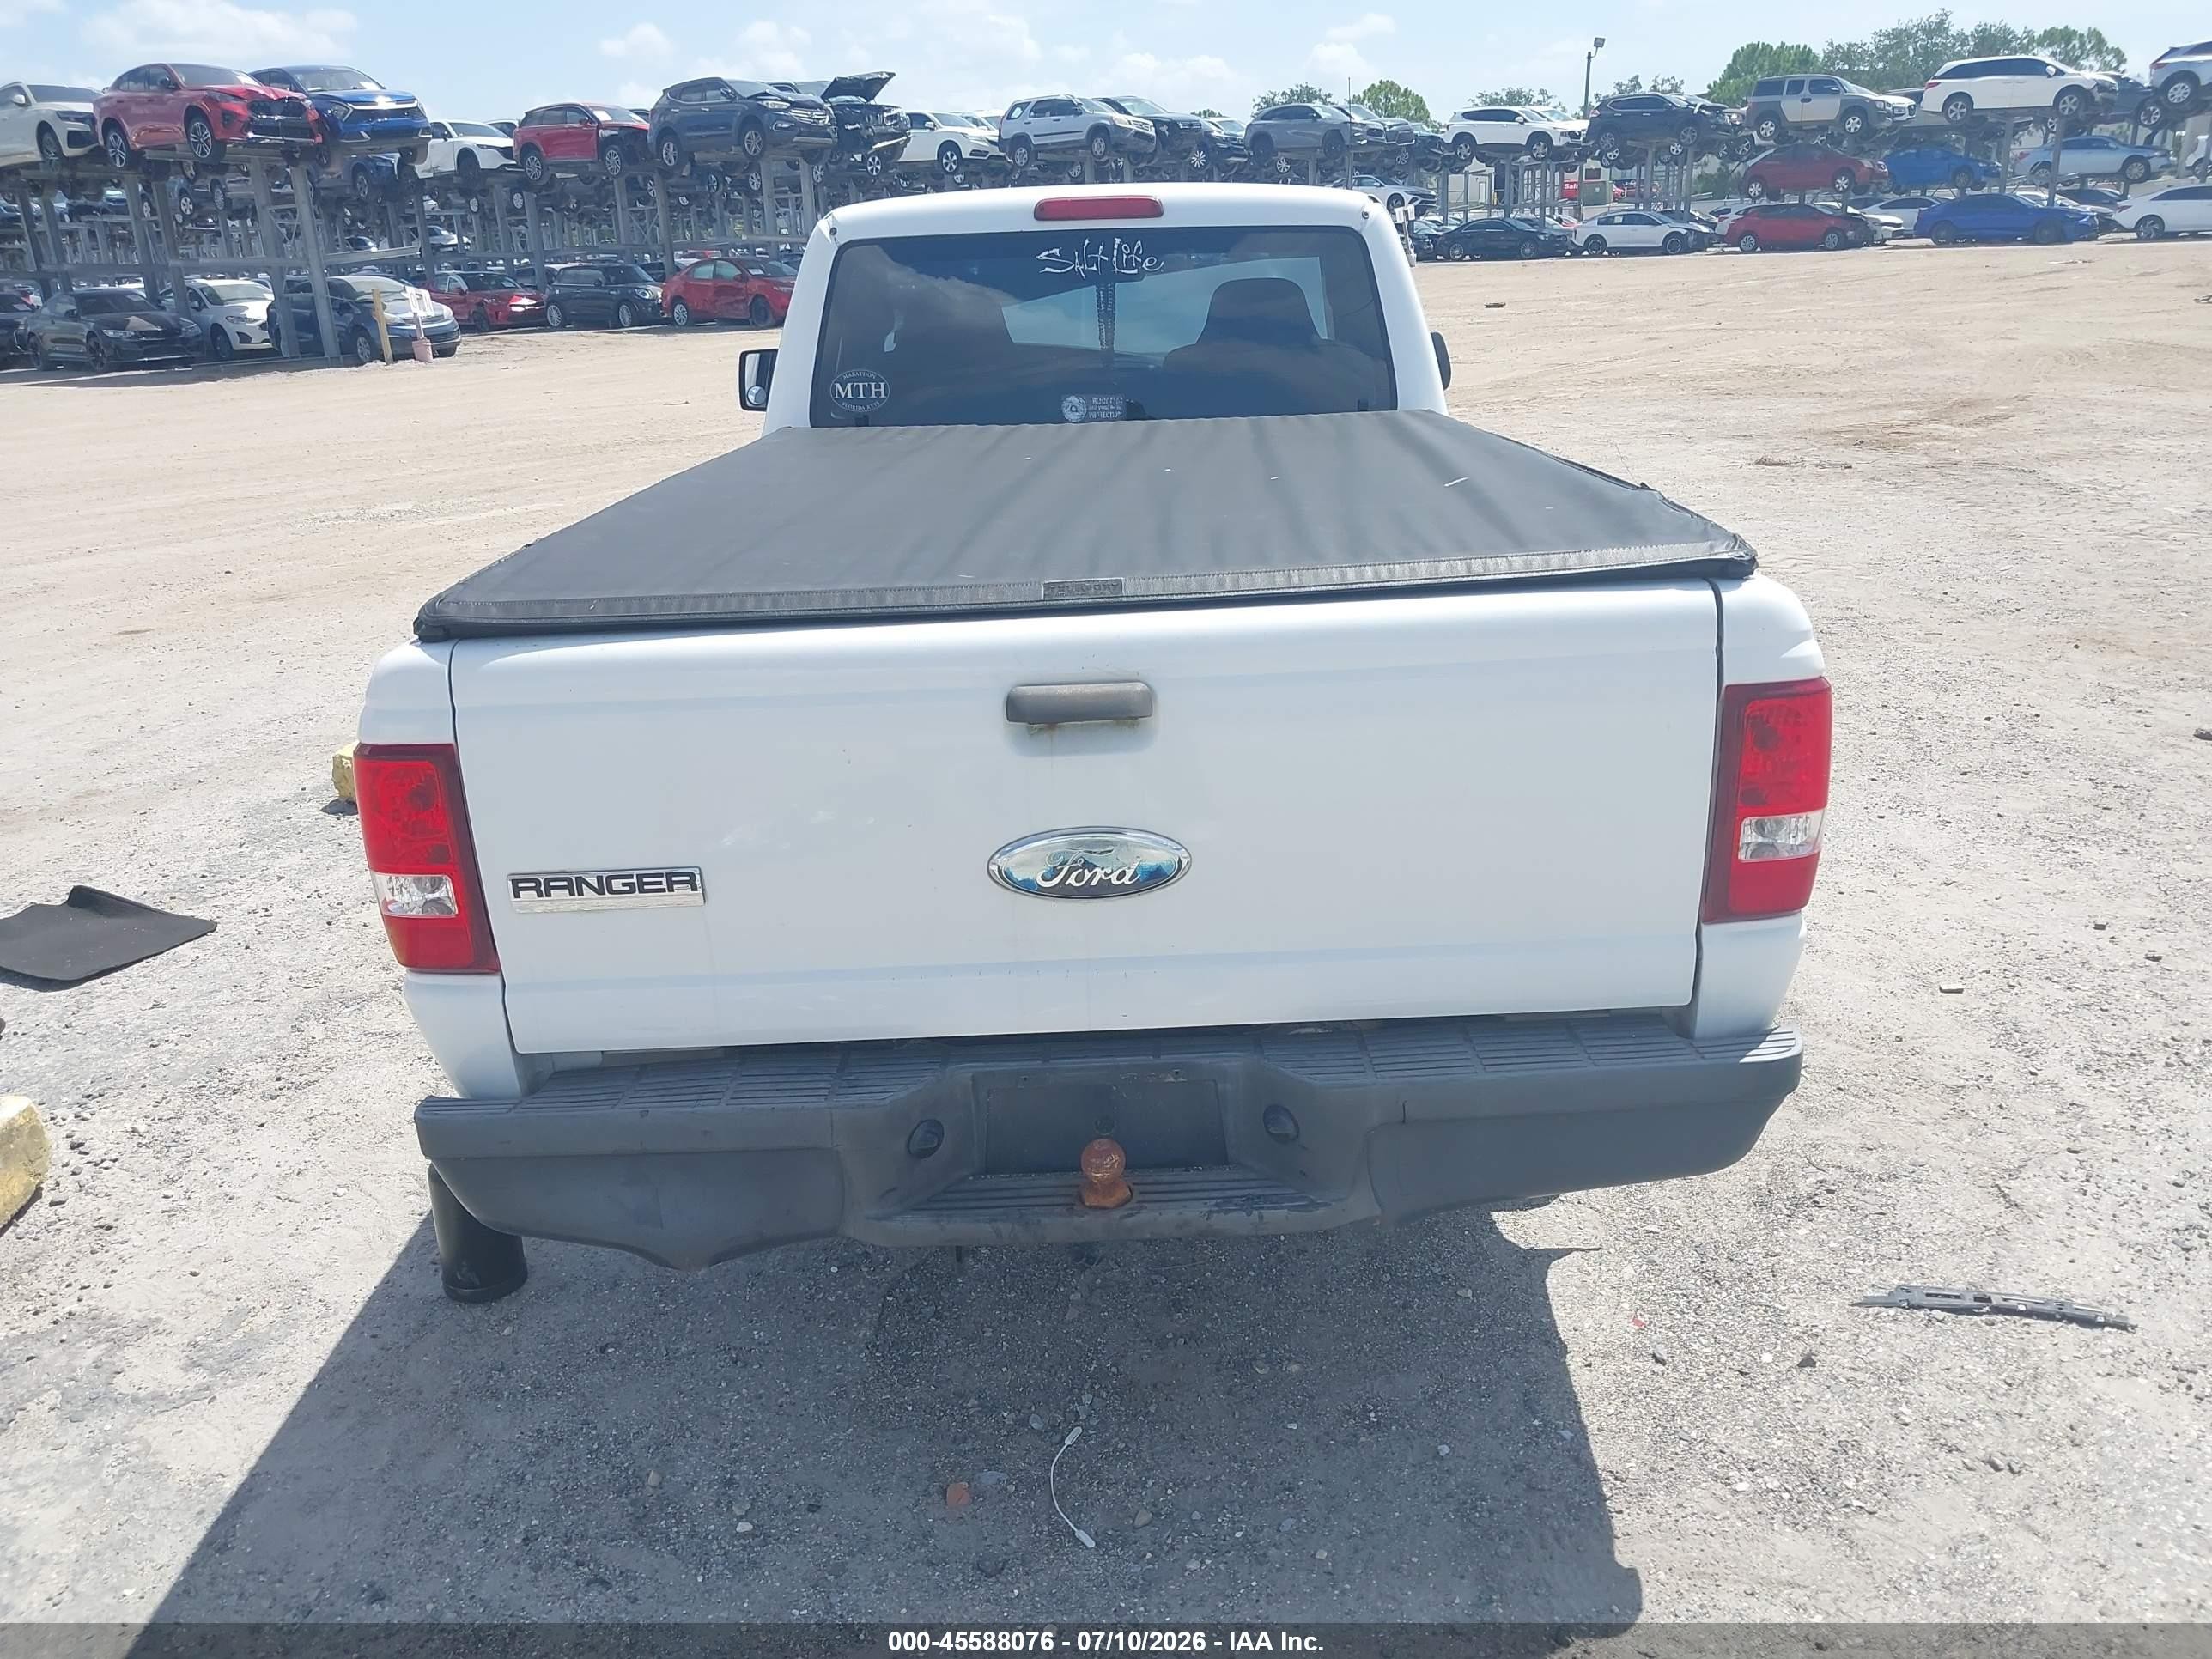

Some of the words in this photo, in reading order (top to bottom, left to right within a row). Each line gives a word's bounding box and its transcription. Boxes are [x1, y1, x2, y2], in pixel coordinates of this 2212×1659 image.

[833, 381, 886, 398] MTH
[1036, 846, 1141, 888] Ford
[511, 871, 699, 899] RANGER
